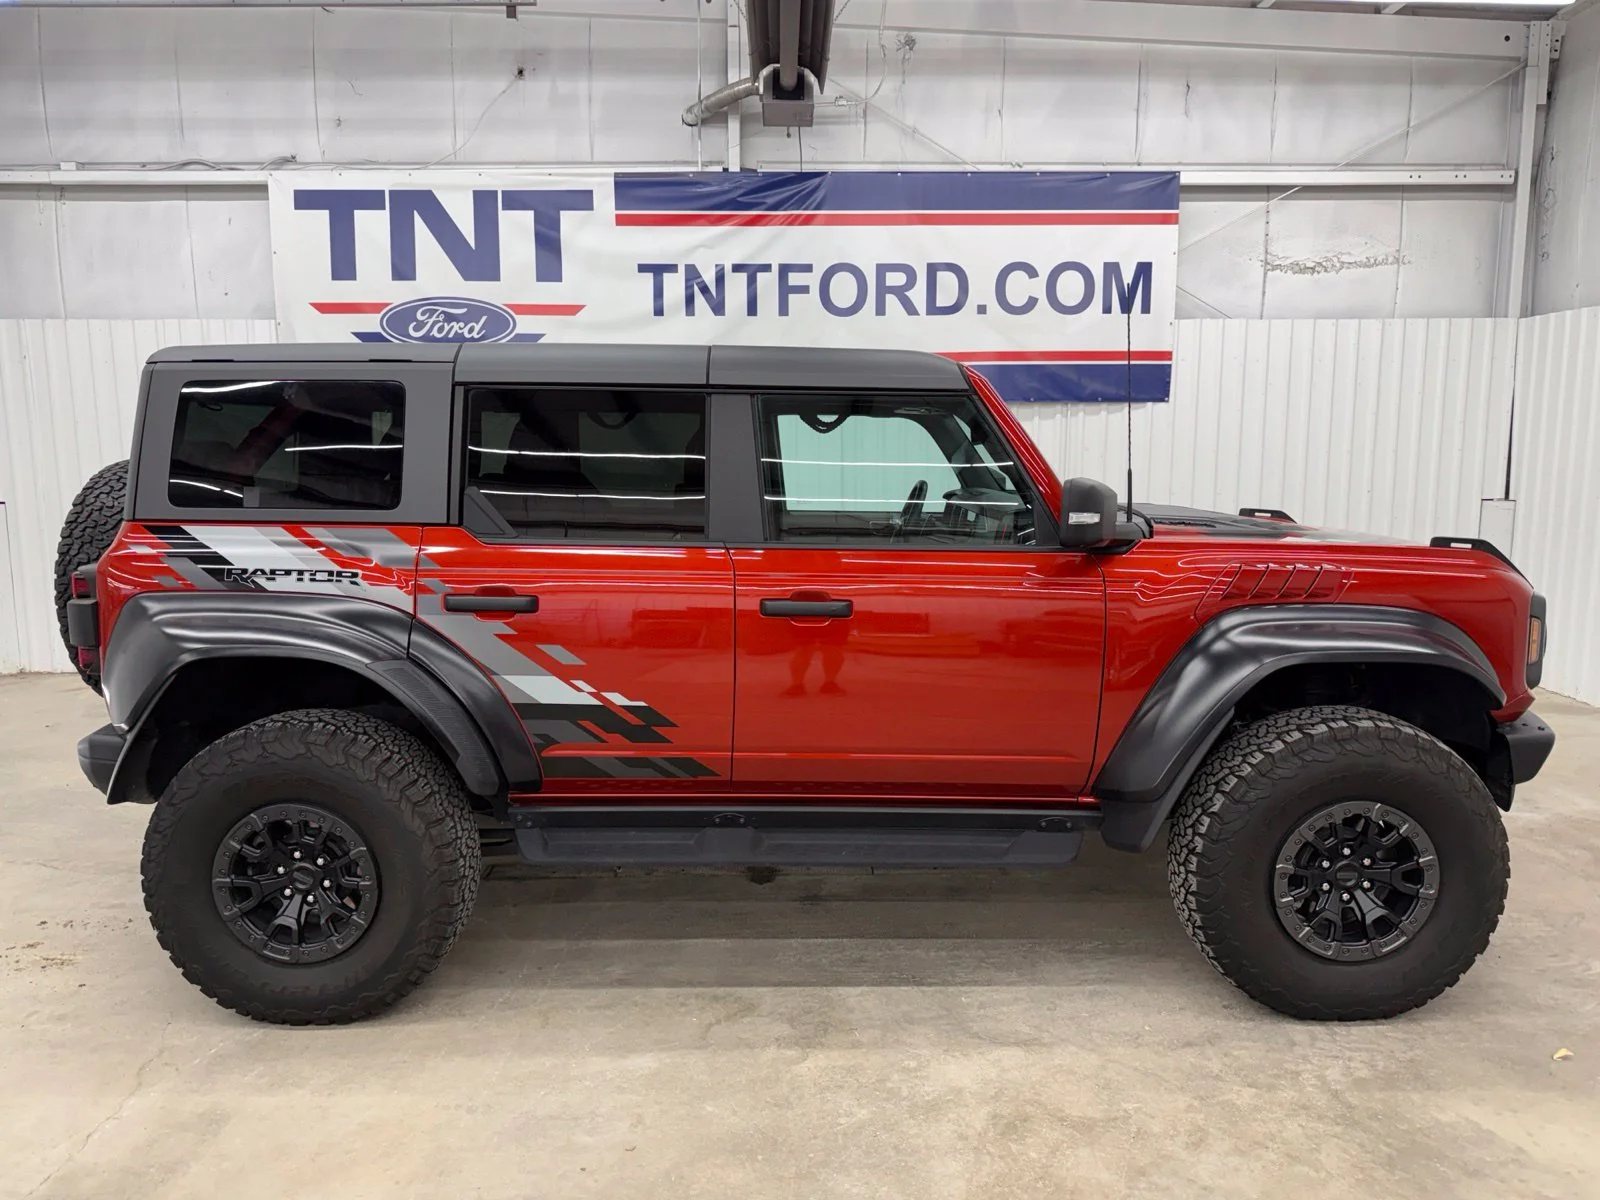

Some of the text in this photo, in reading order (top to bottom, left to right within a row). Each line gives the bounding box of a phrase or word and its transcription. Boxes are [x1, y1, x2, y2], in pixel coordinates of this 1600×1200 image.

[294, 189, 594, 283] TNT
[637, 261, 1152, 318] TNTFORD.COM
[408, 305, 488, 340] Ford
[225, 567, 364, 590] RAPTOR
